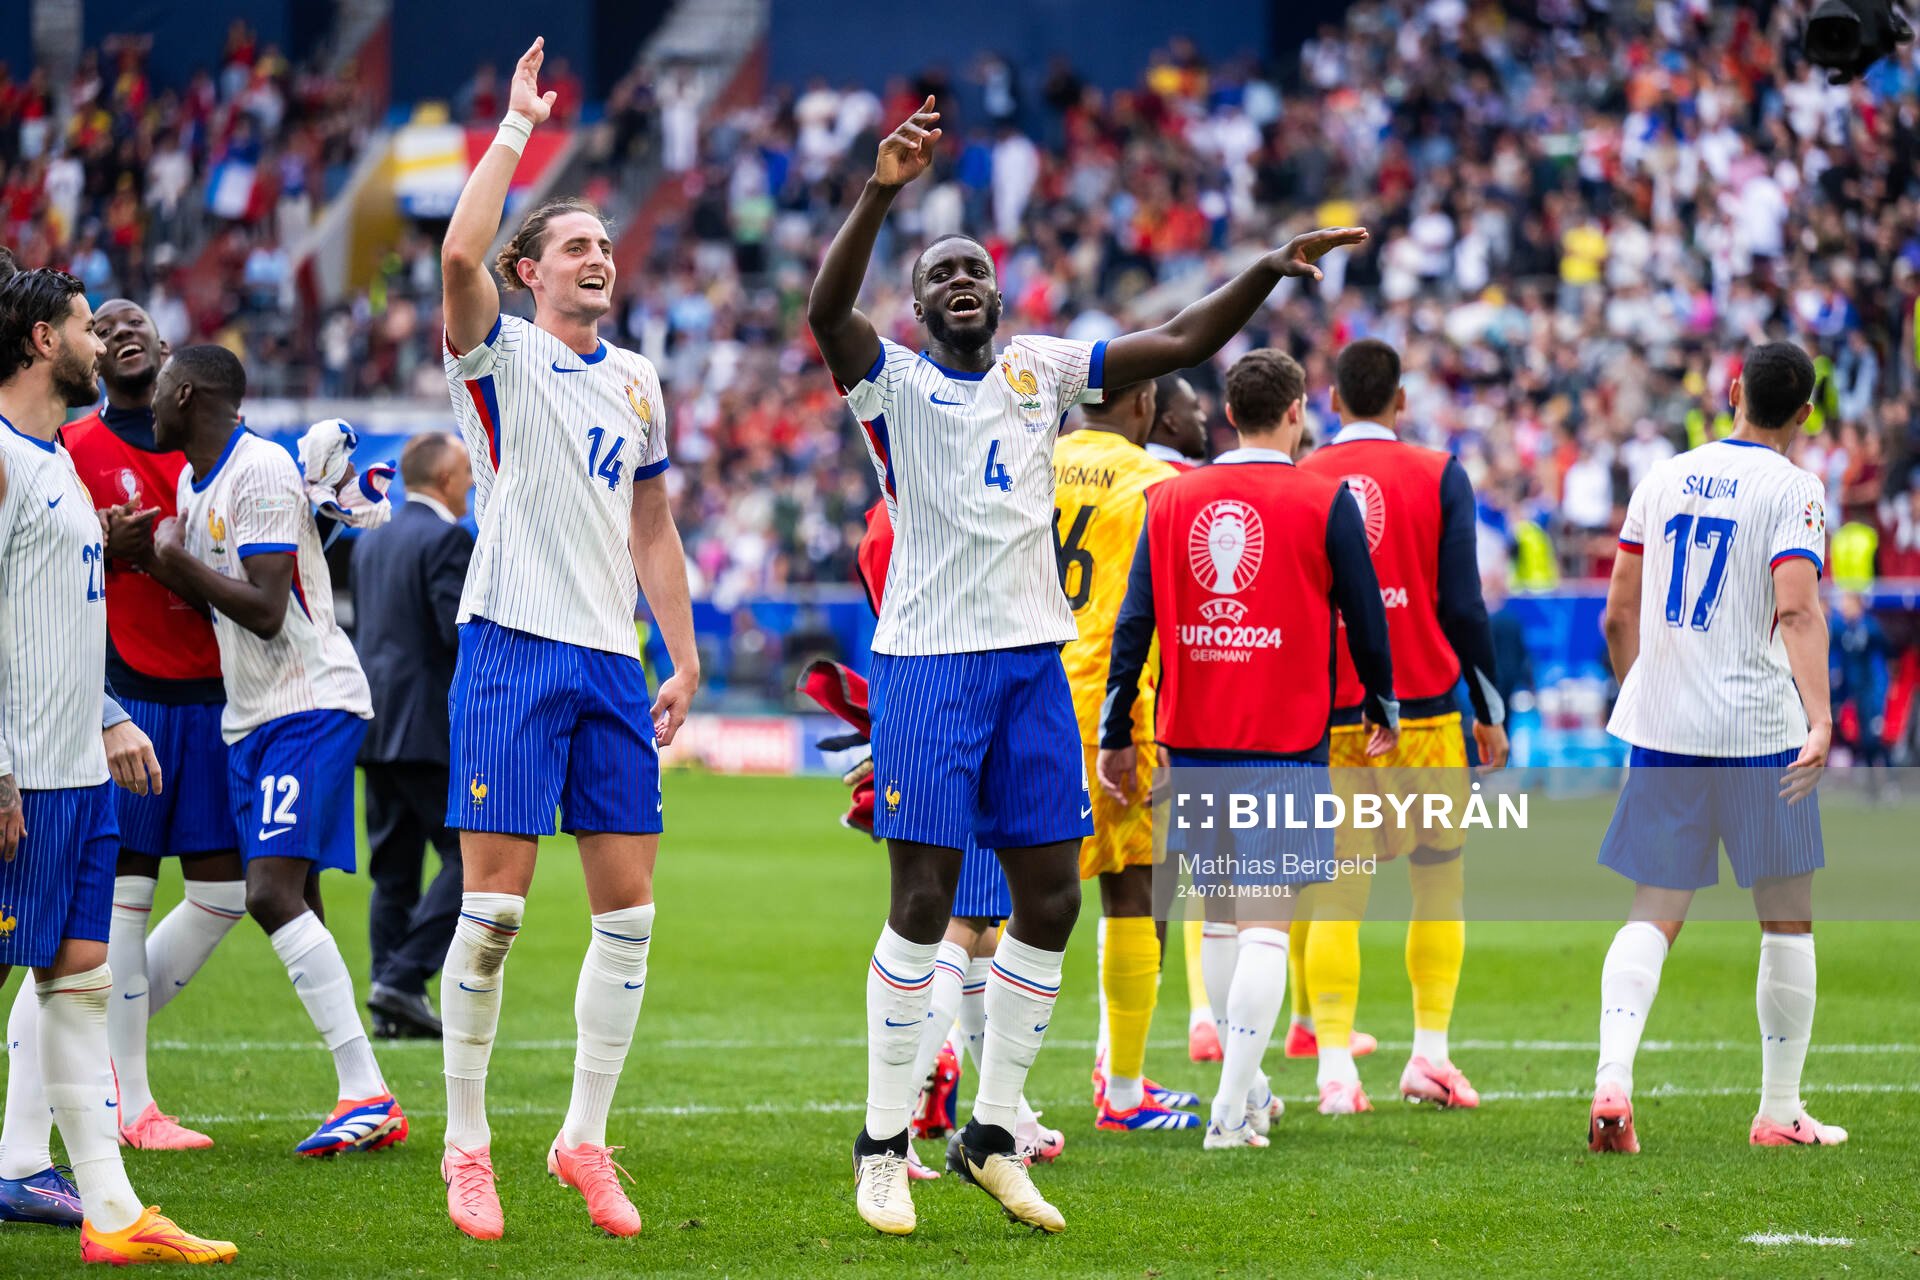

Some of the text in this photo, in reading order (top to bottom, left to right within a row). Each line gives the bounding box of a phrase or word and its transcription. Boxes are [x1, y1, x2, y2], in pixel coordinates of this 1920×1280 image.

[587, 426, 626, 491] 14
[984, 439, 1013, 492] 4
[1053, 465, 1115, 489] IGNAN
[1682, 474, 1739, 499] SALIBA
[1664, 513, 1739, 632] 17
[1200, 601, 1245, 622] UEFA
[1190, 648, 1253, 663] GERMANY
[260, 774, 300, 824] 12
